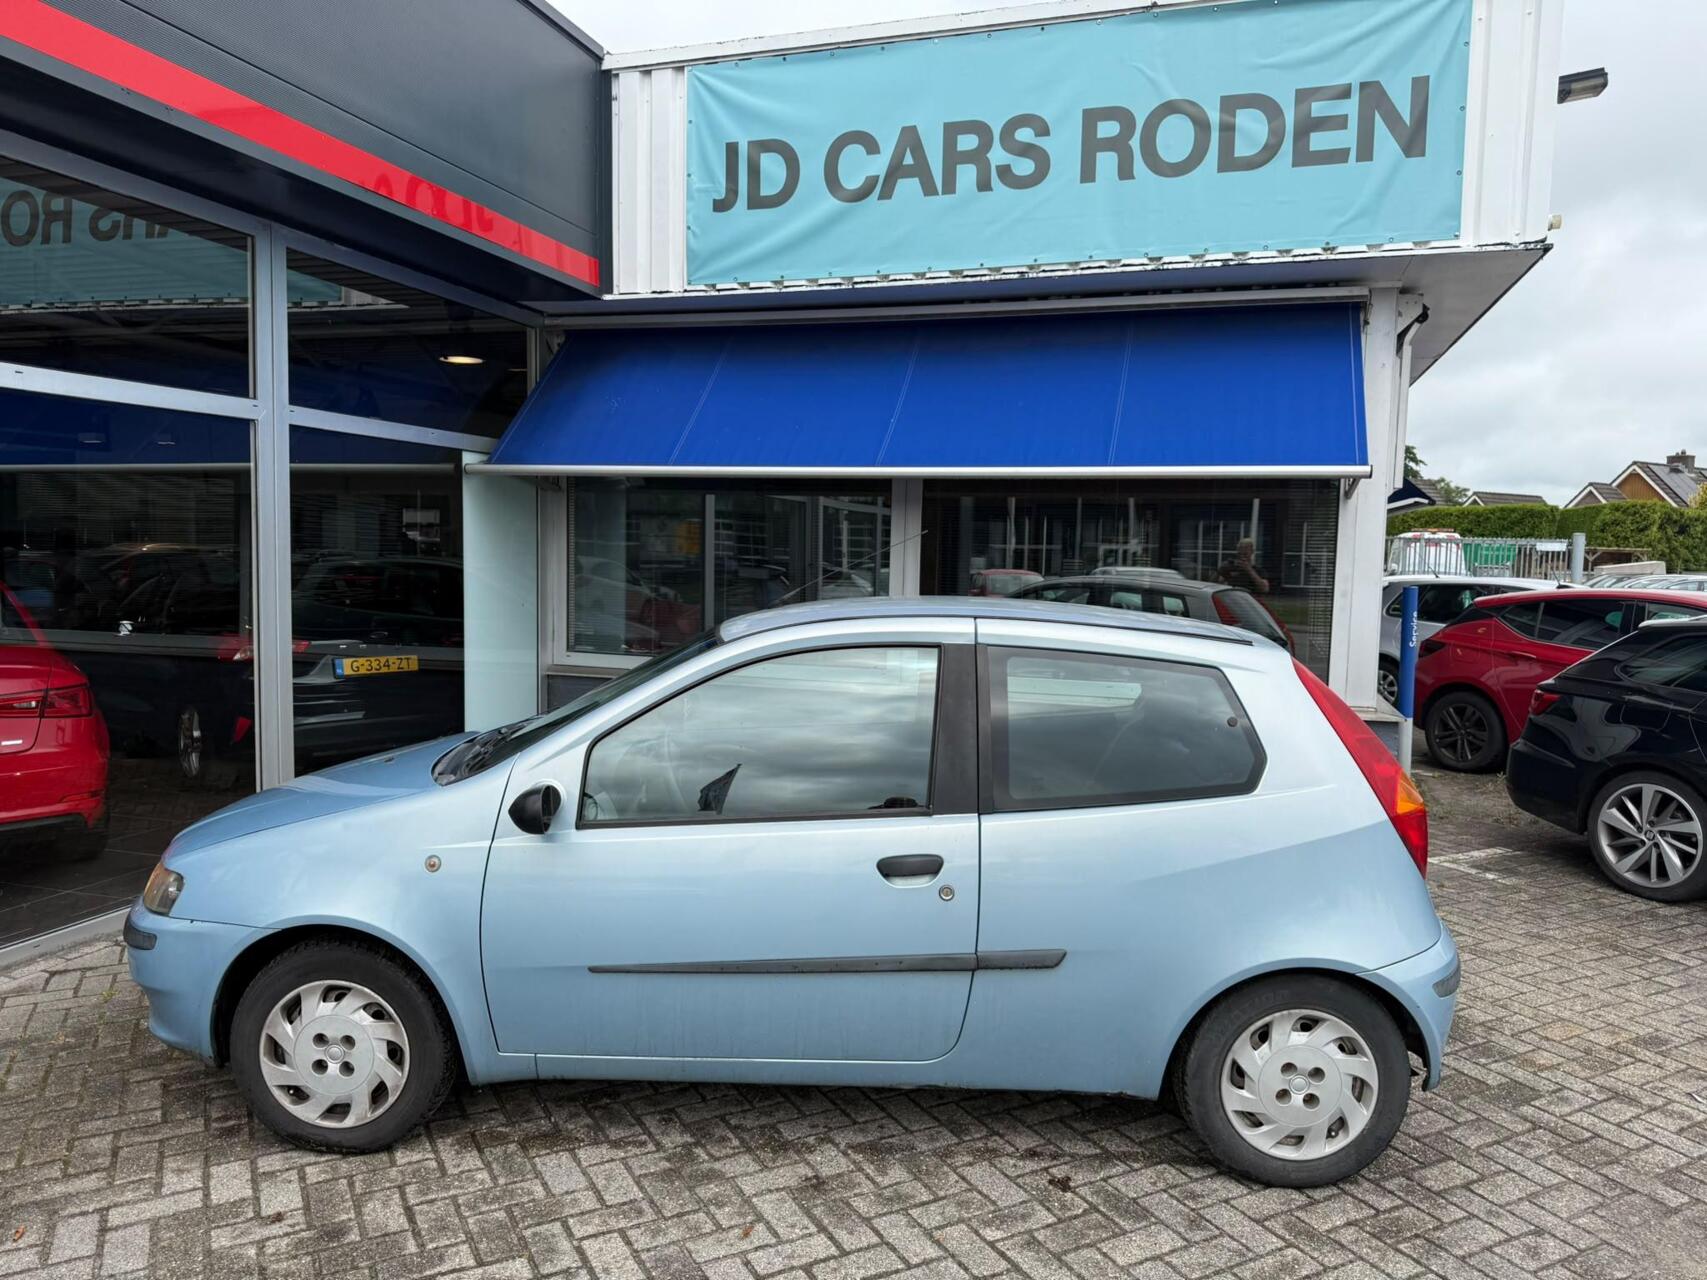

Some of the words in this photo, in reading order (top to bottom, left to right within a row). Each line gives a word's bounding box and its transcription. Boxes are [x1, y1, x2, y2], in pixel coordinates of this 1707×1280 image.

[712, 138, 801, 213] JD
[823, 113, 1051, 204] CARS
[1079, 75, 1430, 185] RODEN
[1408, 611, 1418, 648] Service
[350, 656, 413, 673] G-334-ZT
